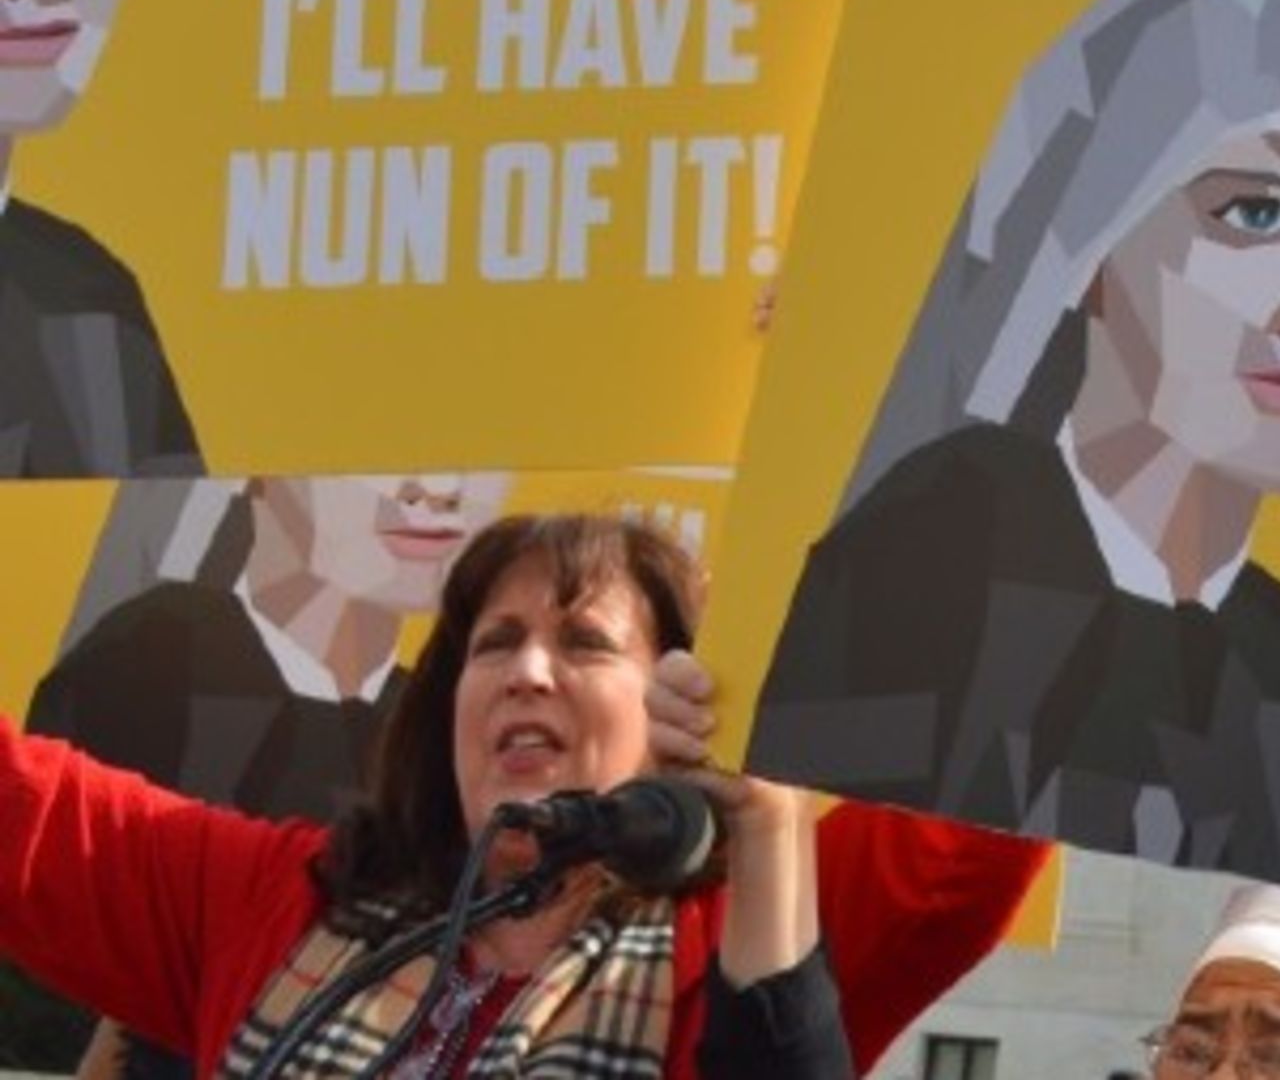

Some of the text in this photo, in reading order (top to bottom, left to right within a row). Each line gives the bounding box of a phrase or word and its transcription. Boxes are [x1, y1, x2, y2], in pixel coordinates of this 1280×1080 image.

[222, 136, 782, 289] NUN OF IT!
